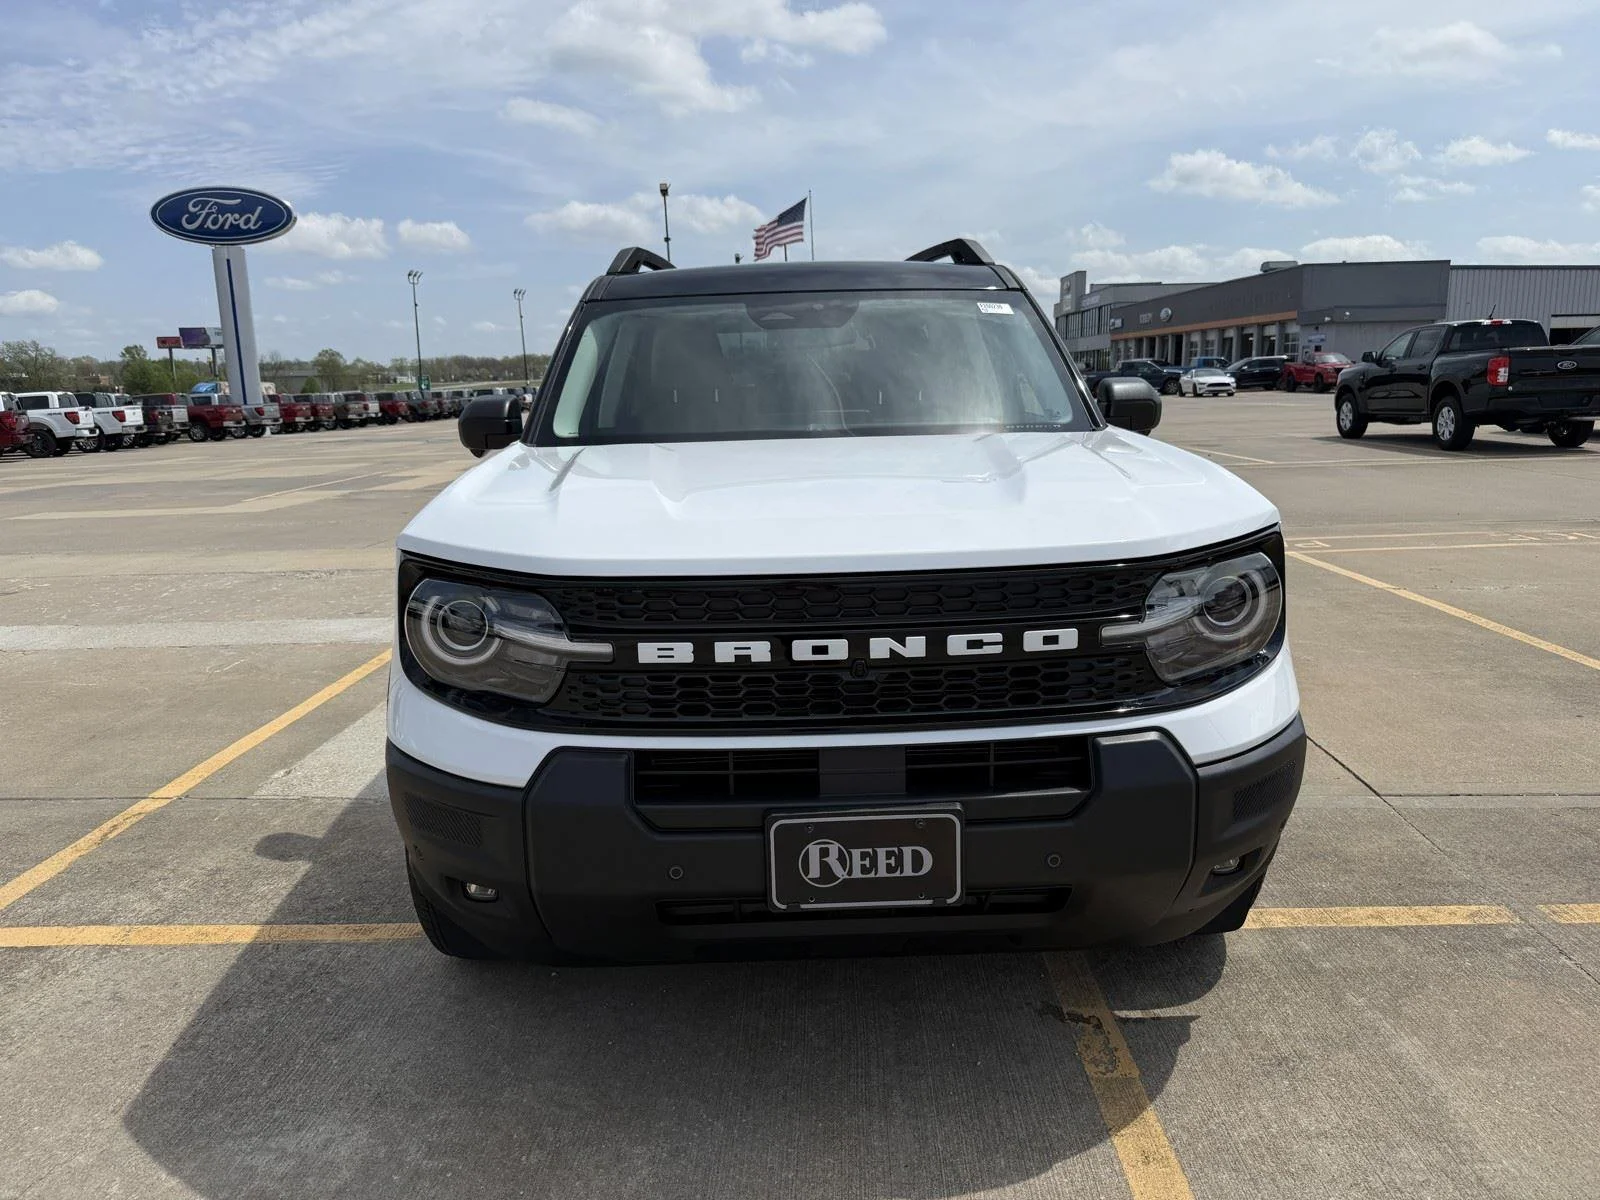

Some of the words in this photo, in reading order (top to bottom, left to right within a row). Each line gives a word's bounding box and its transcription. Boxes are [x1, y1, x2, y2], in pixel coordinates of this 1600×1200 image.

[181, 197, 263, 230] Ford
[637, 627, 1079, 664] BRONCO
[806, 843, 934, 880] REED
